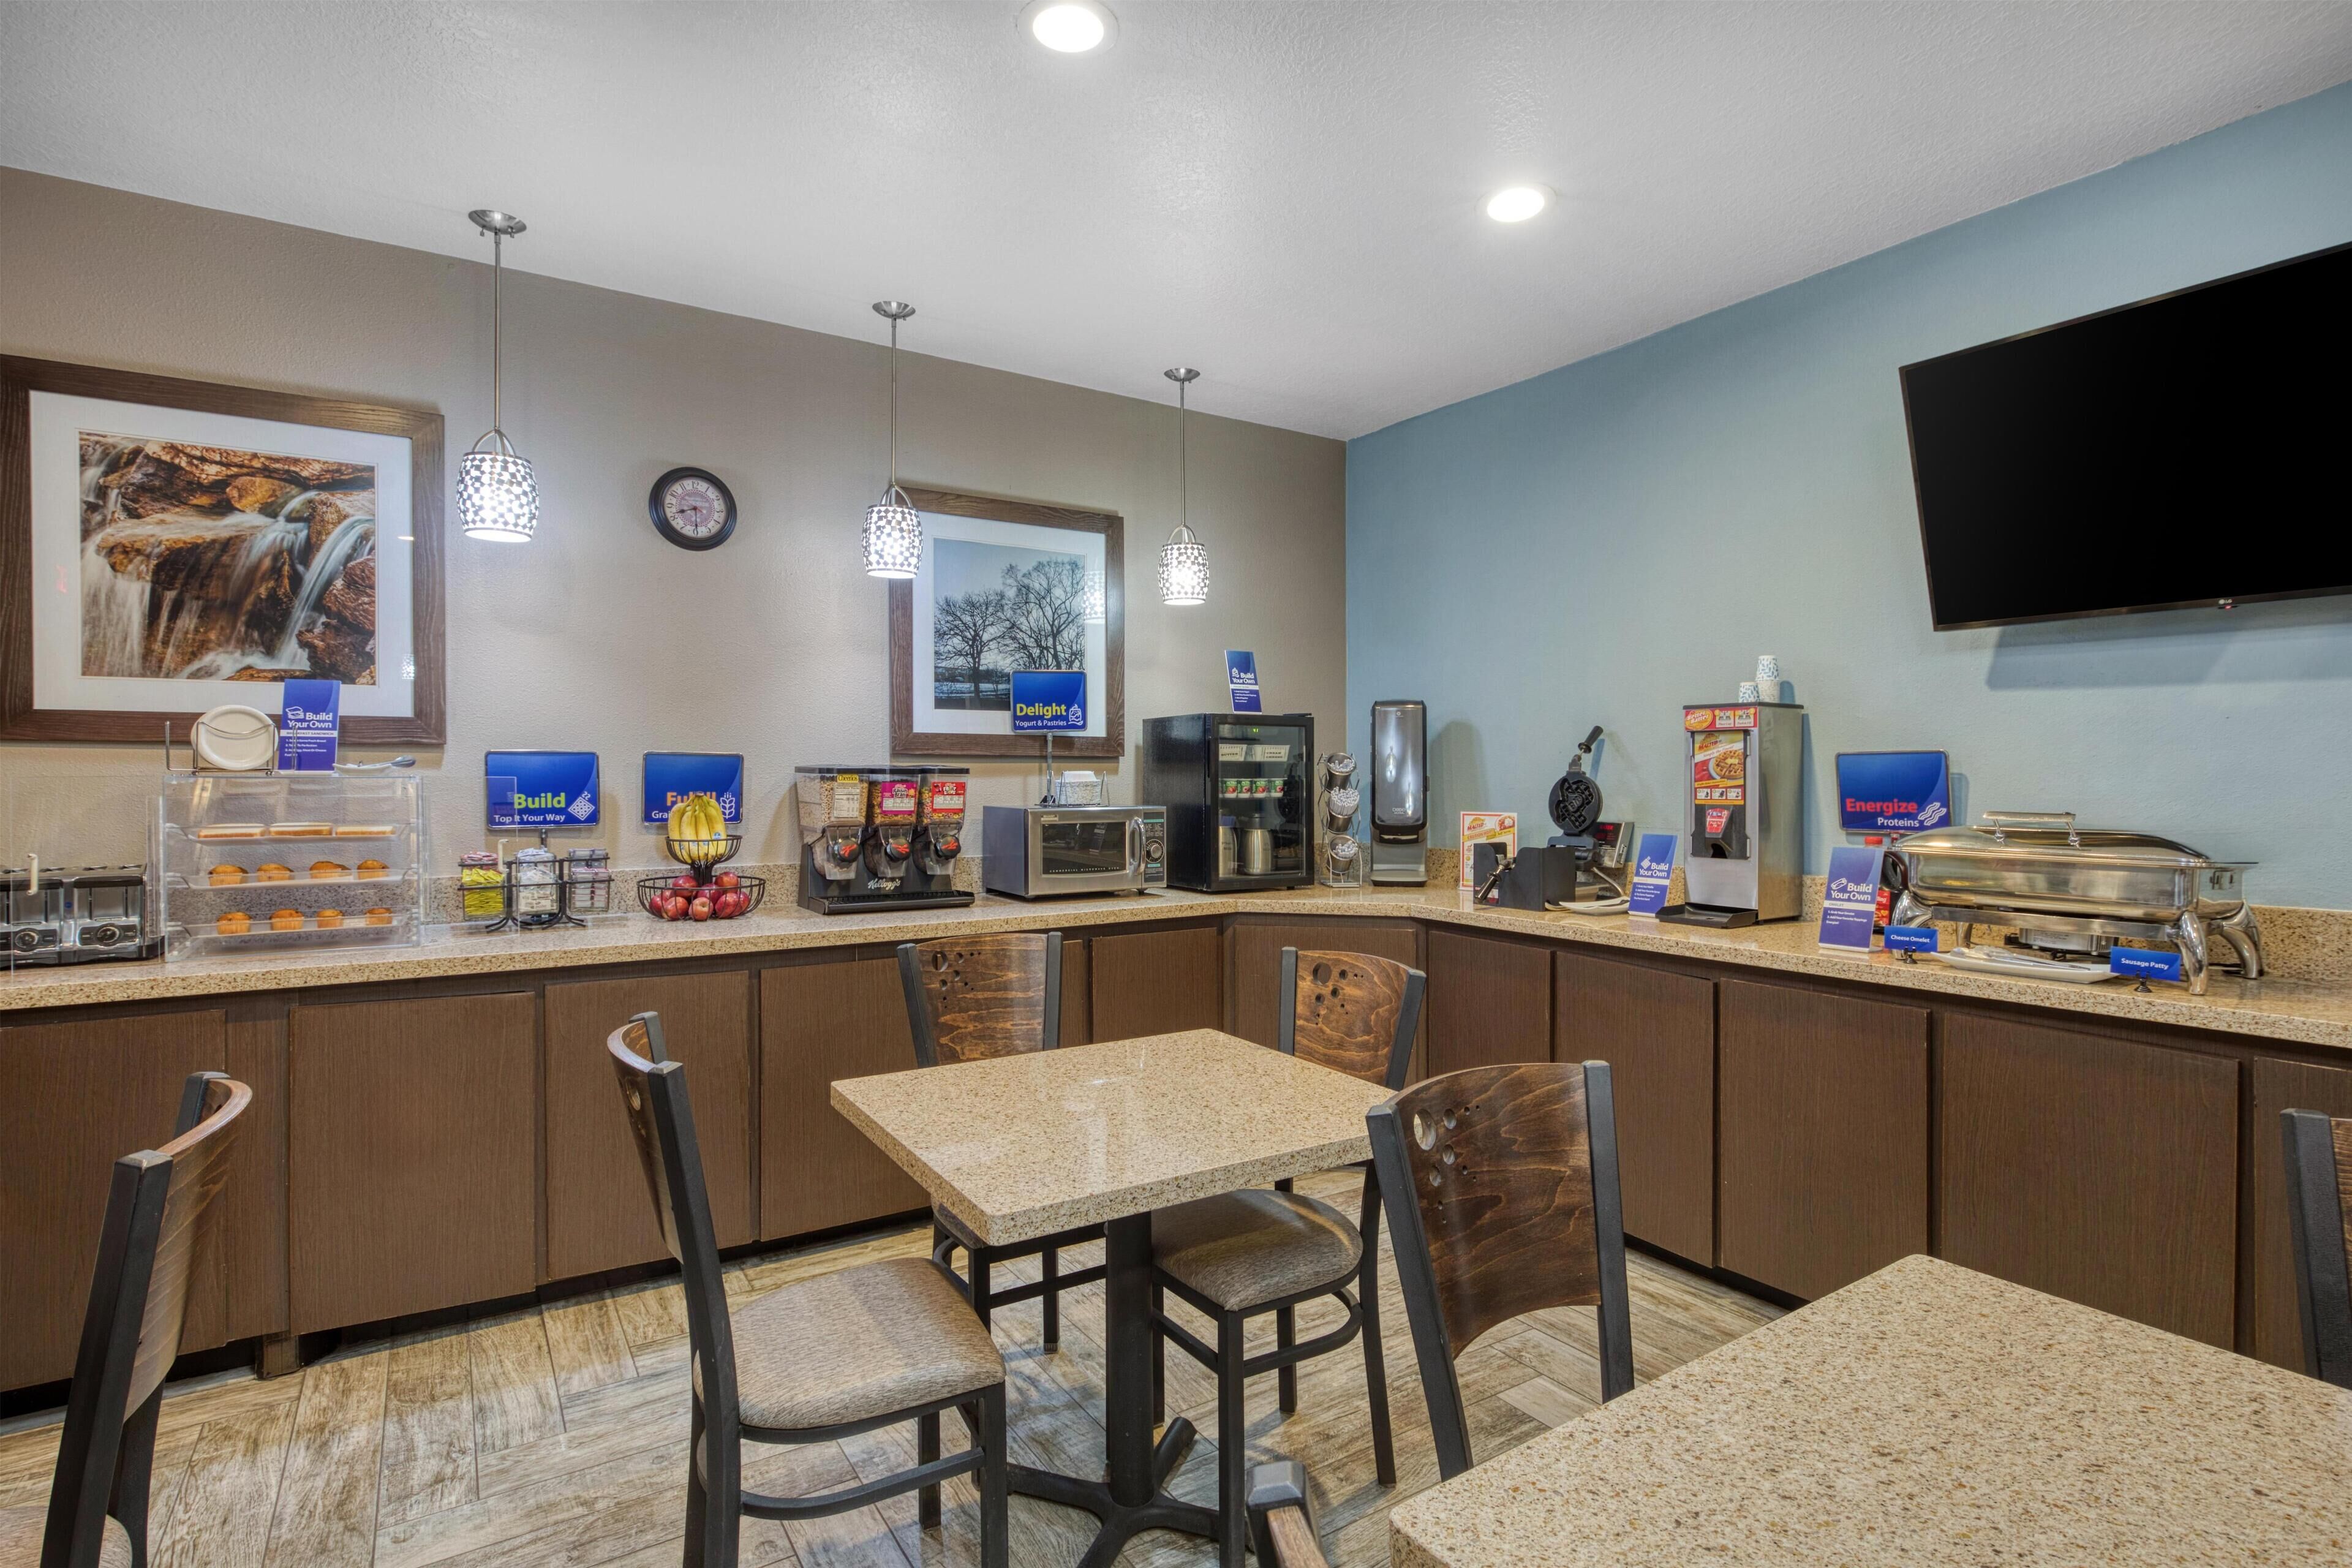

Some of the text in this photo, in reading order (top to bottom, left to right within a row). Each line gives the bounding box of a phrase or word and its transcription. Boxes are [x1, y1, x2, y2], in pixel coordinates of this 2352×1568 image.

[679, 482, 687, 491] 11
[692, 481, 699, 489] 12
[1016, 703, 1067, 718] Delight
[1698, 740, 1719, 752] MALTED
[514, 793, 565, 809] Build
[1845, 798, 1918, 816] Energize
[494, 814, 512, 823] Top
[545, 813, 565, 823] Way
[1877, 817, 1920, 827] Proteins
[1467, 821, 1484, 831] MALTED
[868, 878, 900, 890] Kellogg's
[1847, 883, 1872, 892] Build
[1831, 891, 1871, 901] Your Own
[2121, 958, 2169, 970] Sausage Patty
